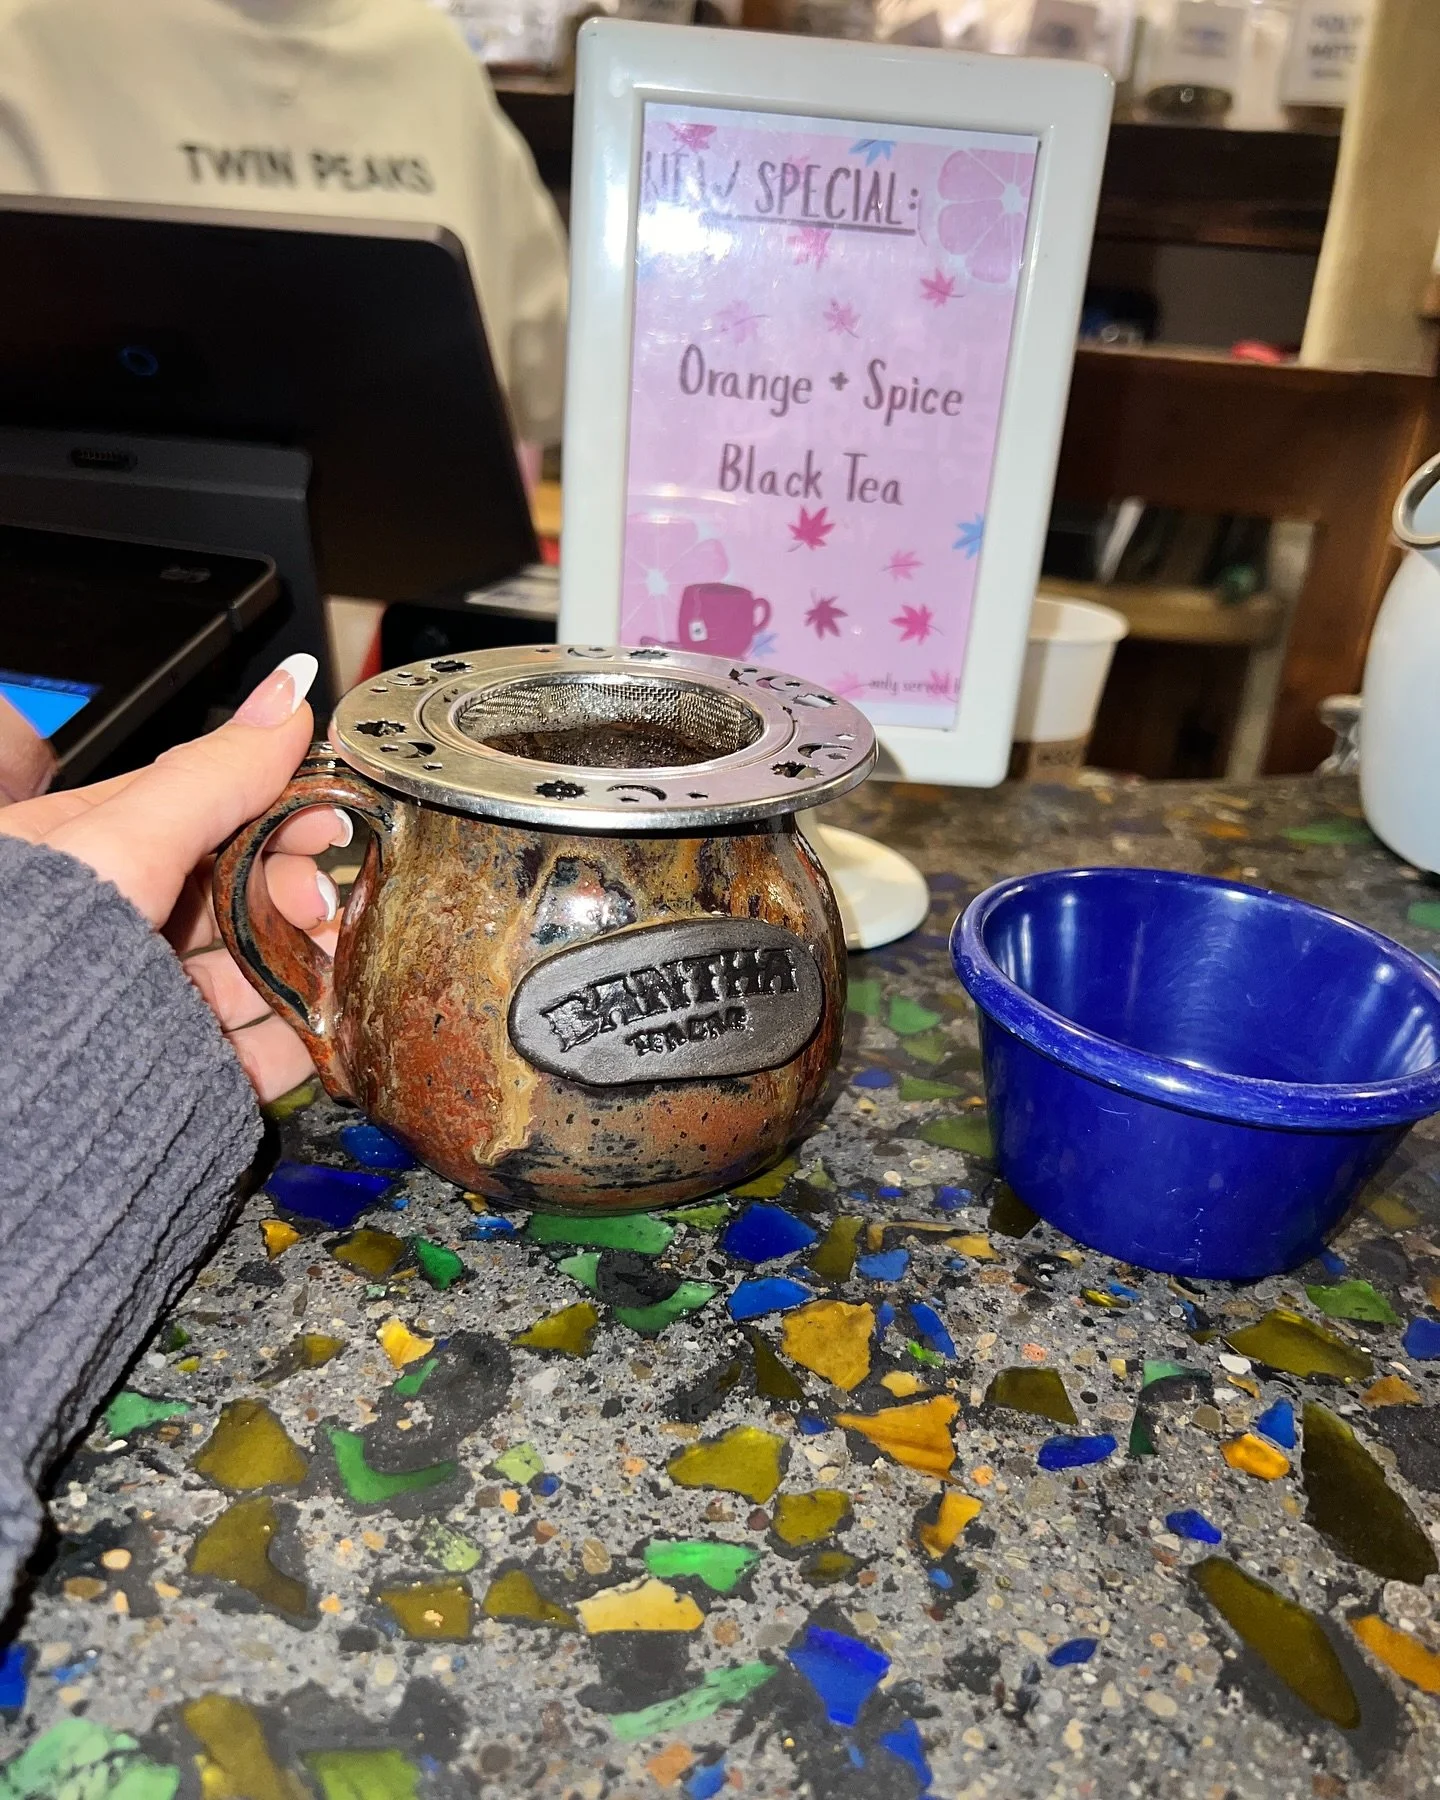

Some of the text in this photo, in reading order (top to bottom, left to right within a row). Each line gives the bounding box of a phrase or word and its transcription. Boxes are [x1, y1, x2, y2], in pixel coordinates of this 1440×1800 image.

[178, 142, 434, 194] TWIN PEAKS
[755, 160, 918, 226] SPECIAL:
[679, 344, 813, 417] Orange
[863, 358, 963, 427] Spice
[719, 443, 904, 506] Black Tea
[540, 948, 800, 1052] BANTHA
